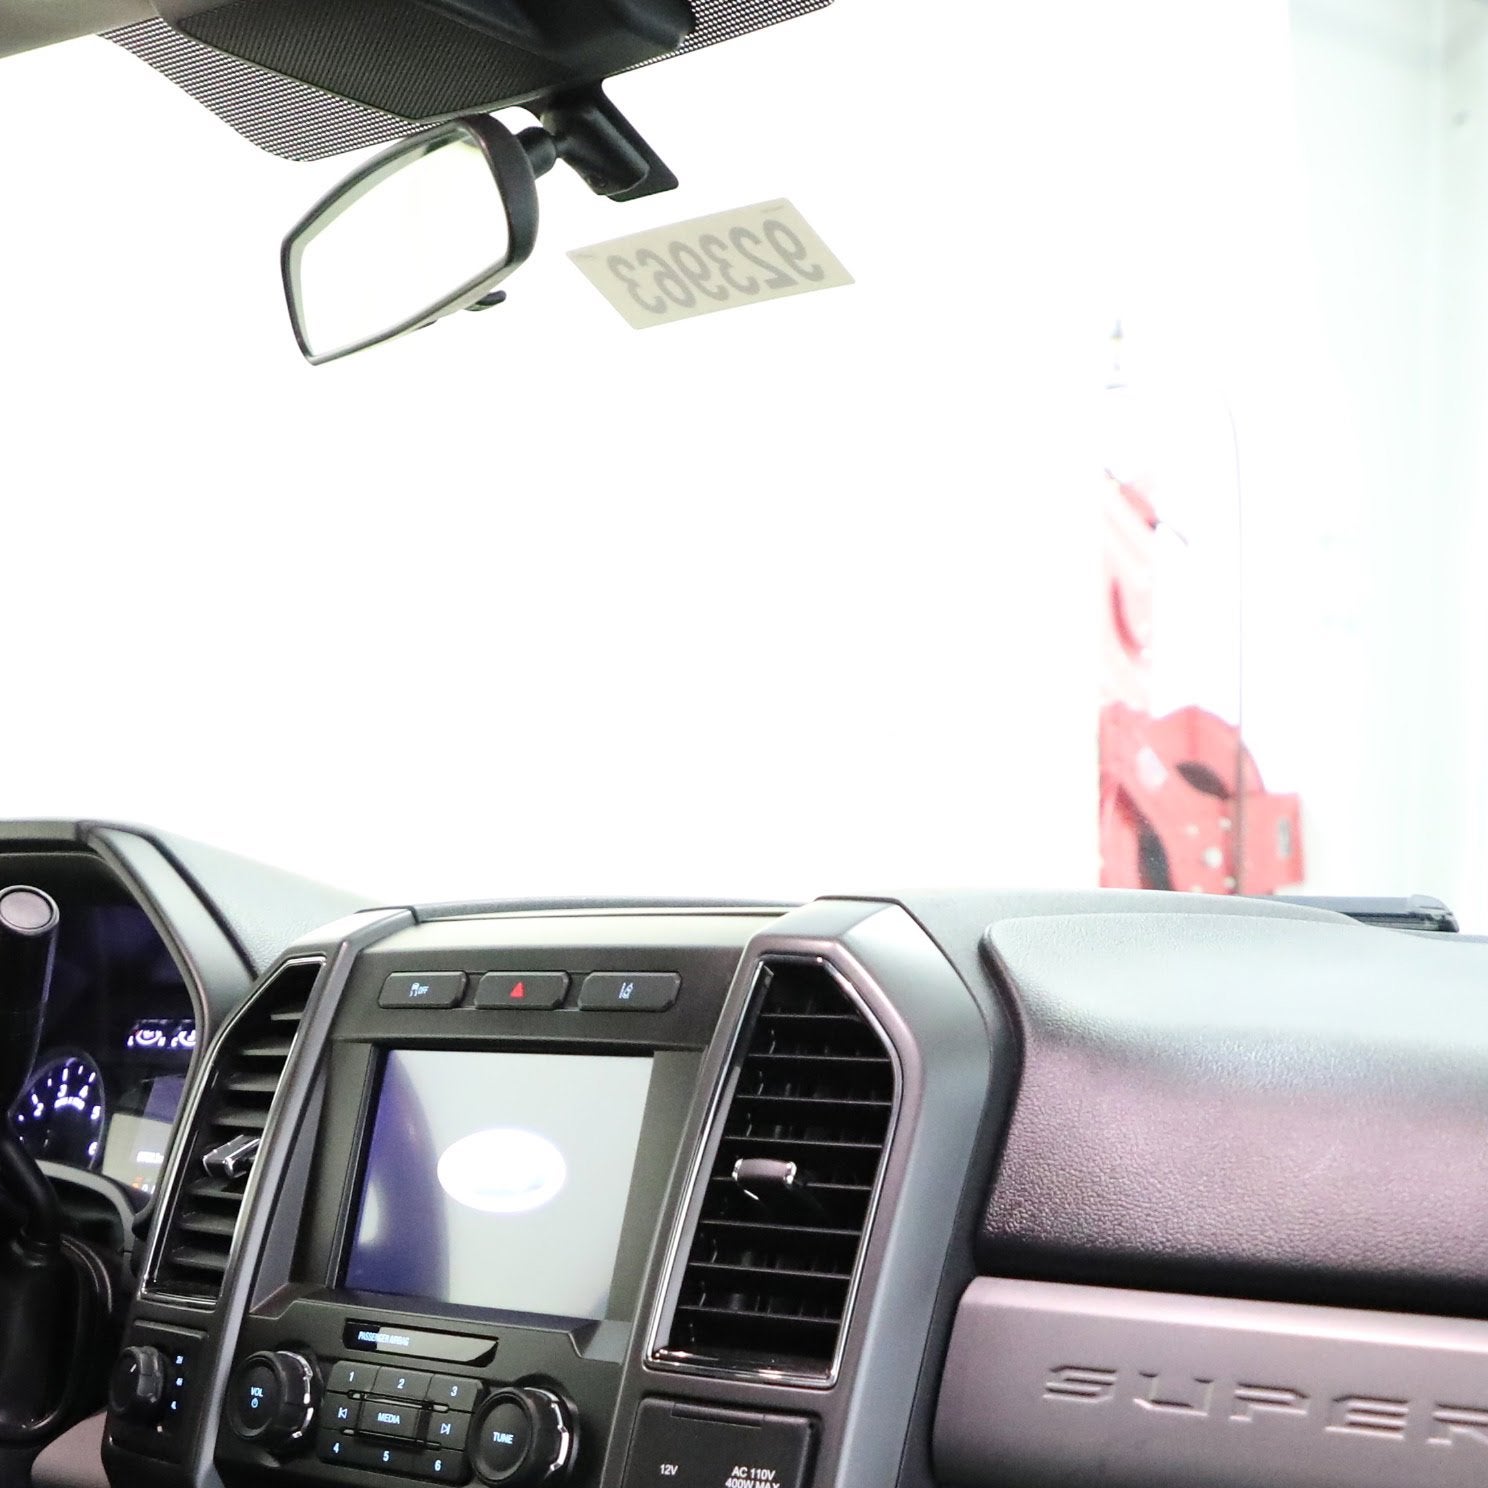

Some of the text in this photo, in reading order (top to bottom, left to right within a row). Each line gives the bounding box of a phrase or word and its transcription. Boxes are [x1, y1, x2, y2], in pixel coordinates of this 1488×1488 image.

[349, 1371, 355, 1382] 1
[397, 1378, 405, 1389] 2
[250, 1386, 264, 1398] VOL
[450, 1385, 458, 1396] 3
[377, 1412, 401, 1425] MEDIA
[492, 1431, 515, 1445] TUNE
[333, 1443, 340, 1453] 4
[383, 1450, 390, 1462] 5
[434, 1459, 442, 1471] 6
[660, 1464, 679, 1476] 12V
[731, 1466, 776, 1481] AC 110V
